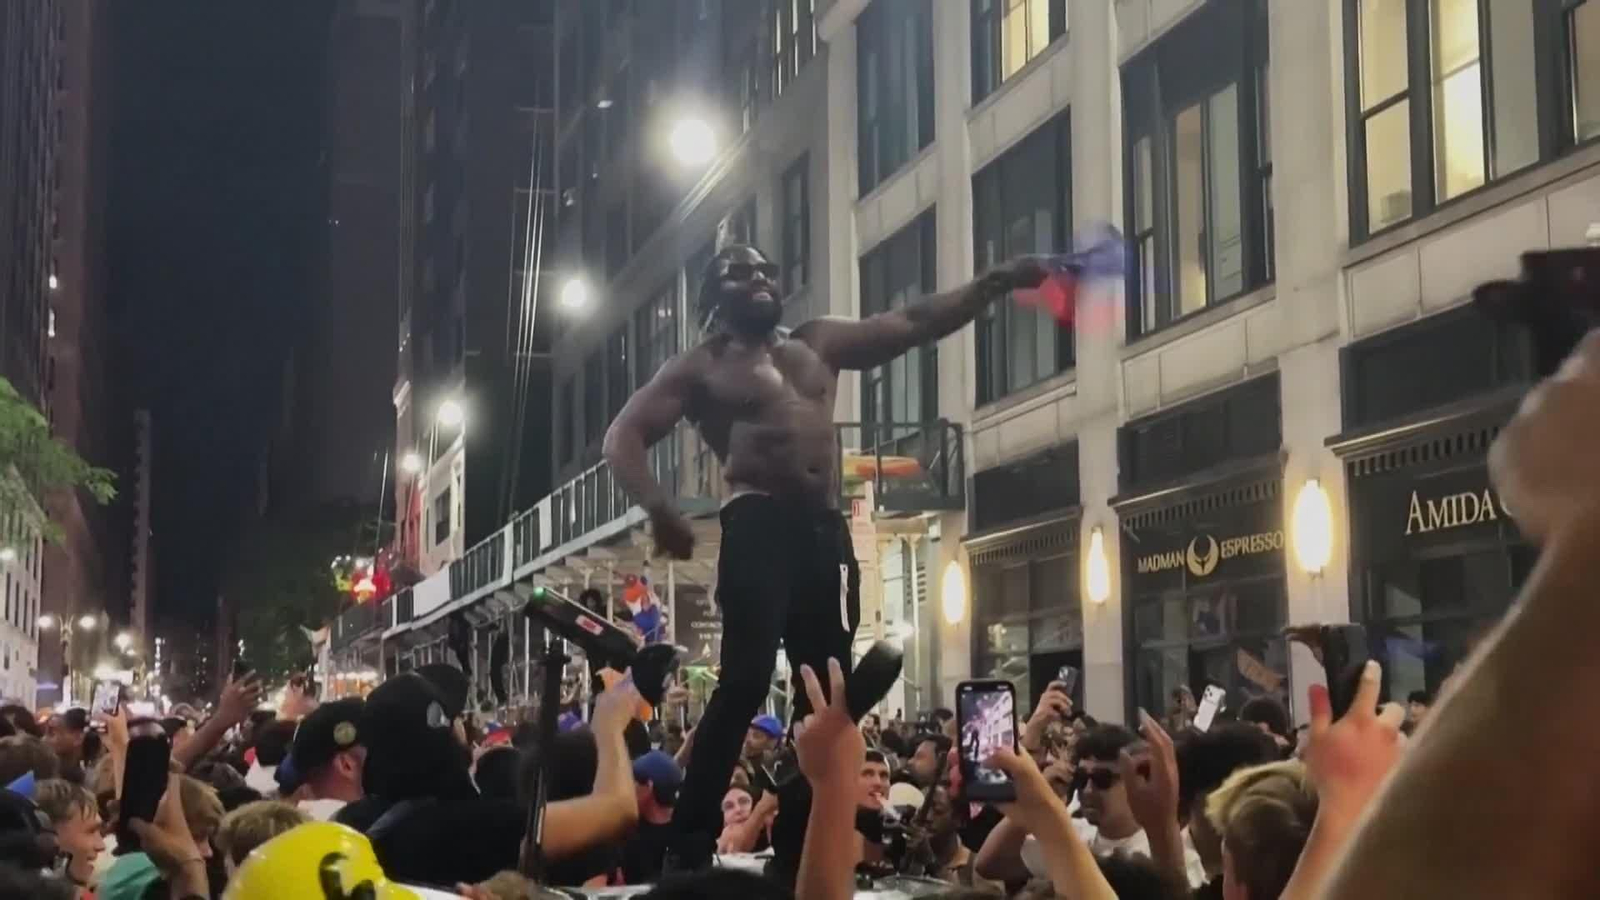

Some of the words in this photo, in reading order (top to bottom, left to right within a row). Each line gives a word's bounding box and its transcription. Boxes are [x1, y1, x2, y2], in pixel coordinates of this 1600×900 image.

[1405, 489, 1497, 535] AMIDA
[1138, 551, 1185, 573] MADMAN
[1221, 530, 1284, 559] ESPRESSO
